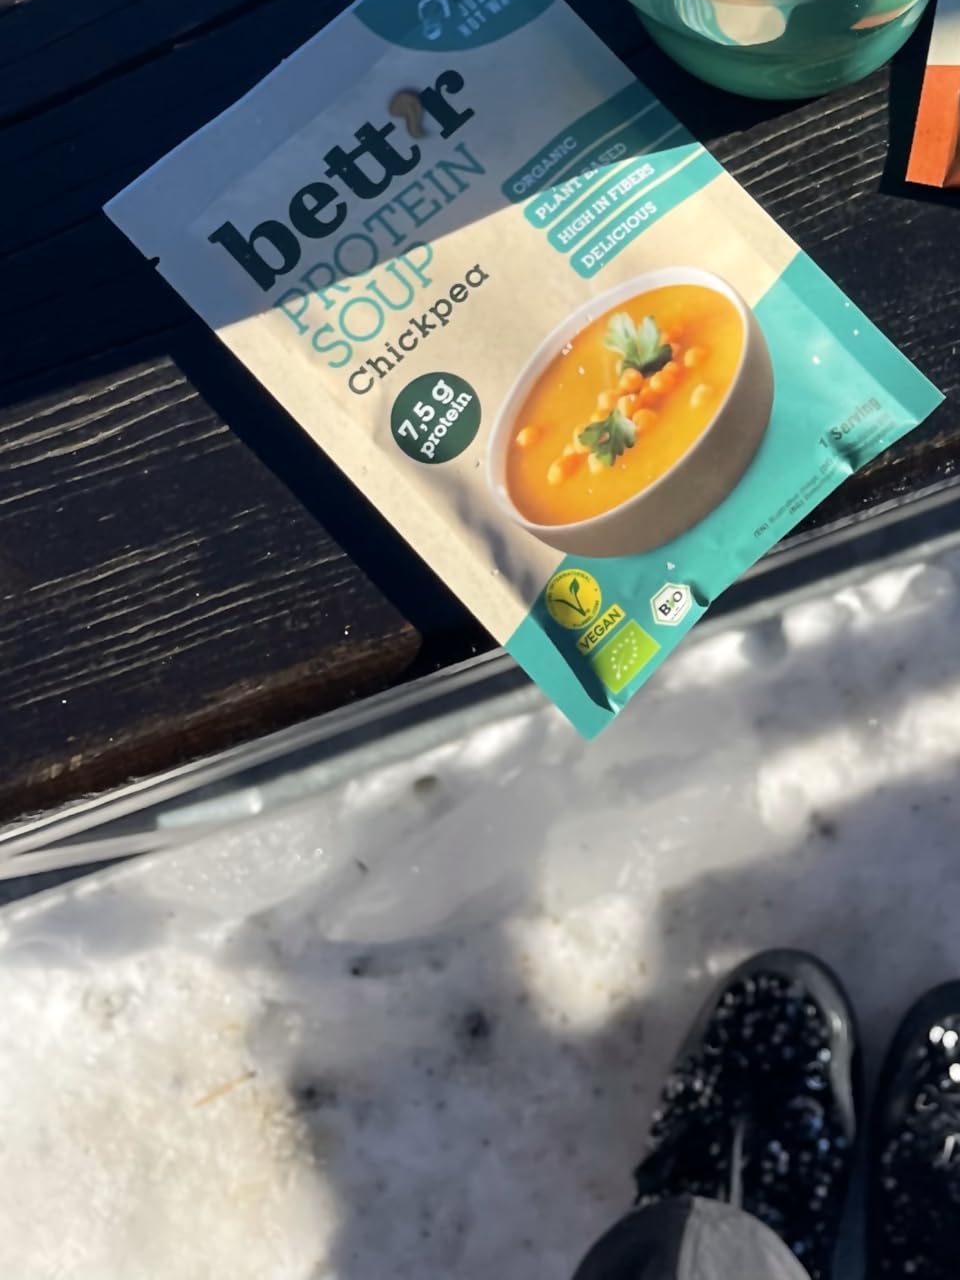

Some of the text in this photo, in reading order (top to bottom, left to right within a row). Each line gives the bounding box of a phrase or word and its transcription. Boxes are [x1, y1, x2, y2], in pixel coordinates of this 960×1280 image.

[512, 136, 577, 194] ORGANIC
[535, 142, 627, 220] PLANT BASED
[557, 162, 656, 245] HIGH IN FIBERS
[581, 201, 657, 269] DELICIOUS
[274, 142, 487, 336] PROTEIN
[311, 239, 434, 369] SOUP
[347, 263, 490, 395] Chickpea
[397, 379, 454, 440] 7,5 g
[420, 392, 472, 459] protein
[818, 437, 829, 449] 1
[830, 397, 881, 441] Serving
[579, 608, 622, 650] VEGAN
